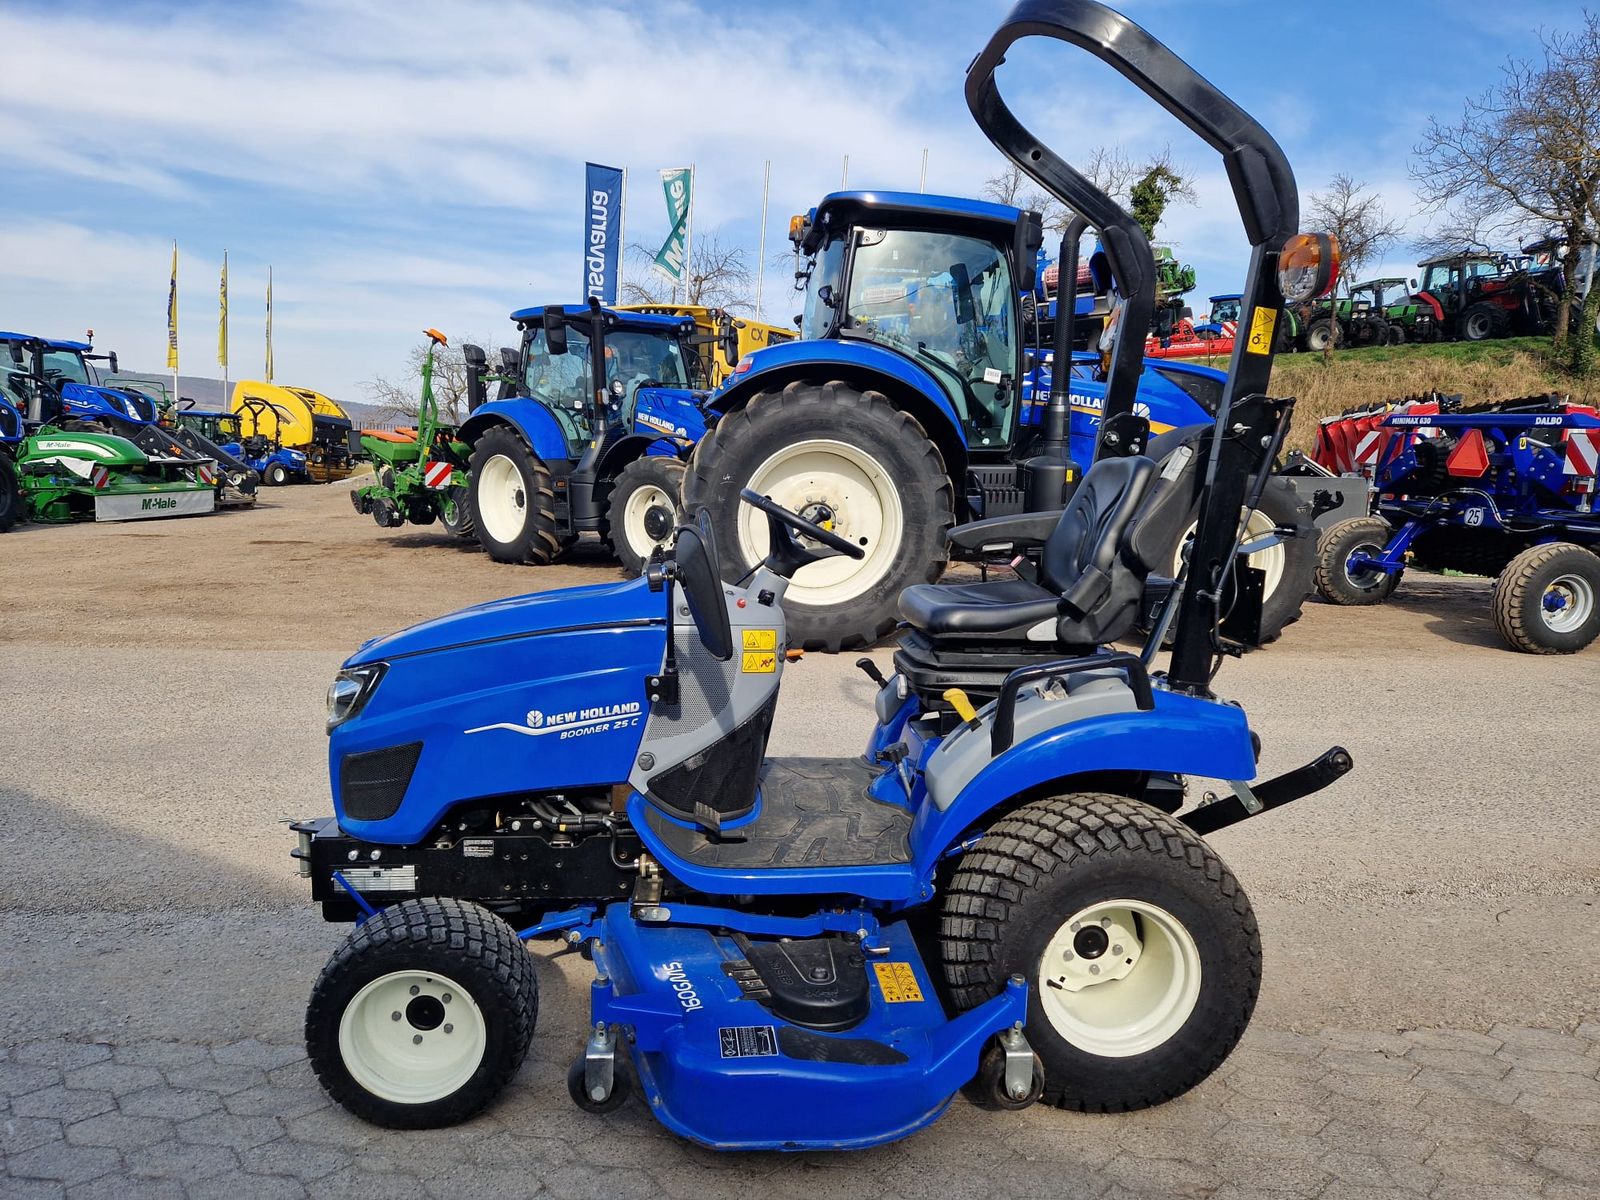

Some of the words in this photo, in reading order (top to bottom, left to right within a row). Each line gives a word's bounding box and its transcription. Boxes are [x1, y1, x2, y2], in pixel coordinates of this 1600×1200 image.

[750, 328, 763, 341] CX
[637, 412, 649, 422] NEW
[650, 415, 675, 432] HOLLAND
[1392, 417, 1419, 425] MINIMAX
[1535, 416, 1563, 425] DALBO
[1467, 509, 1481, 524] 25
[546, 711, 577, 726] NEW
[580, 702, 640, 720] HOLLAND
[560, 723, 609, 740] BOOMER
[613, 719, 628, 730] 25
[631, 718, 639, 726] C
